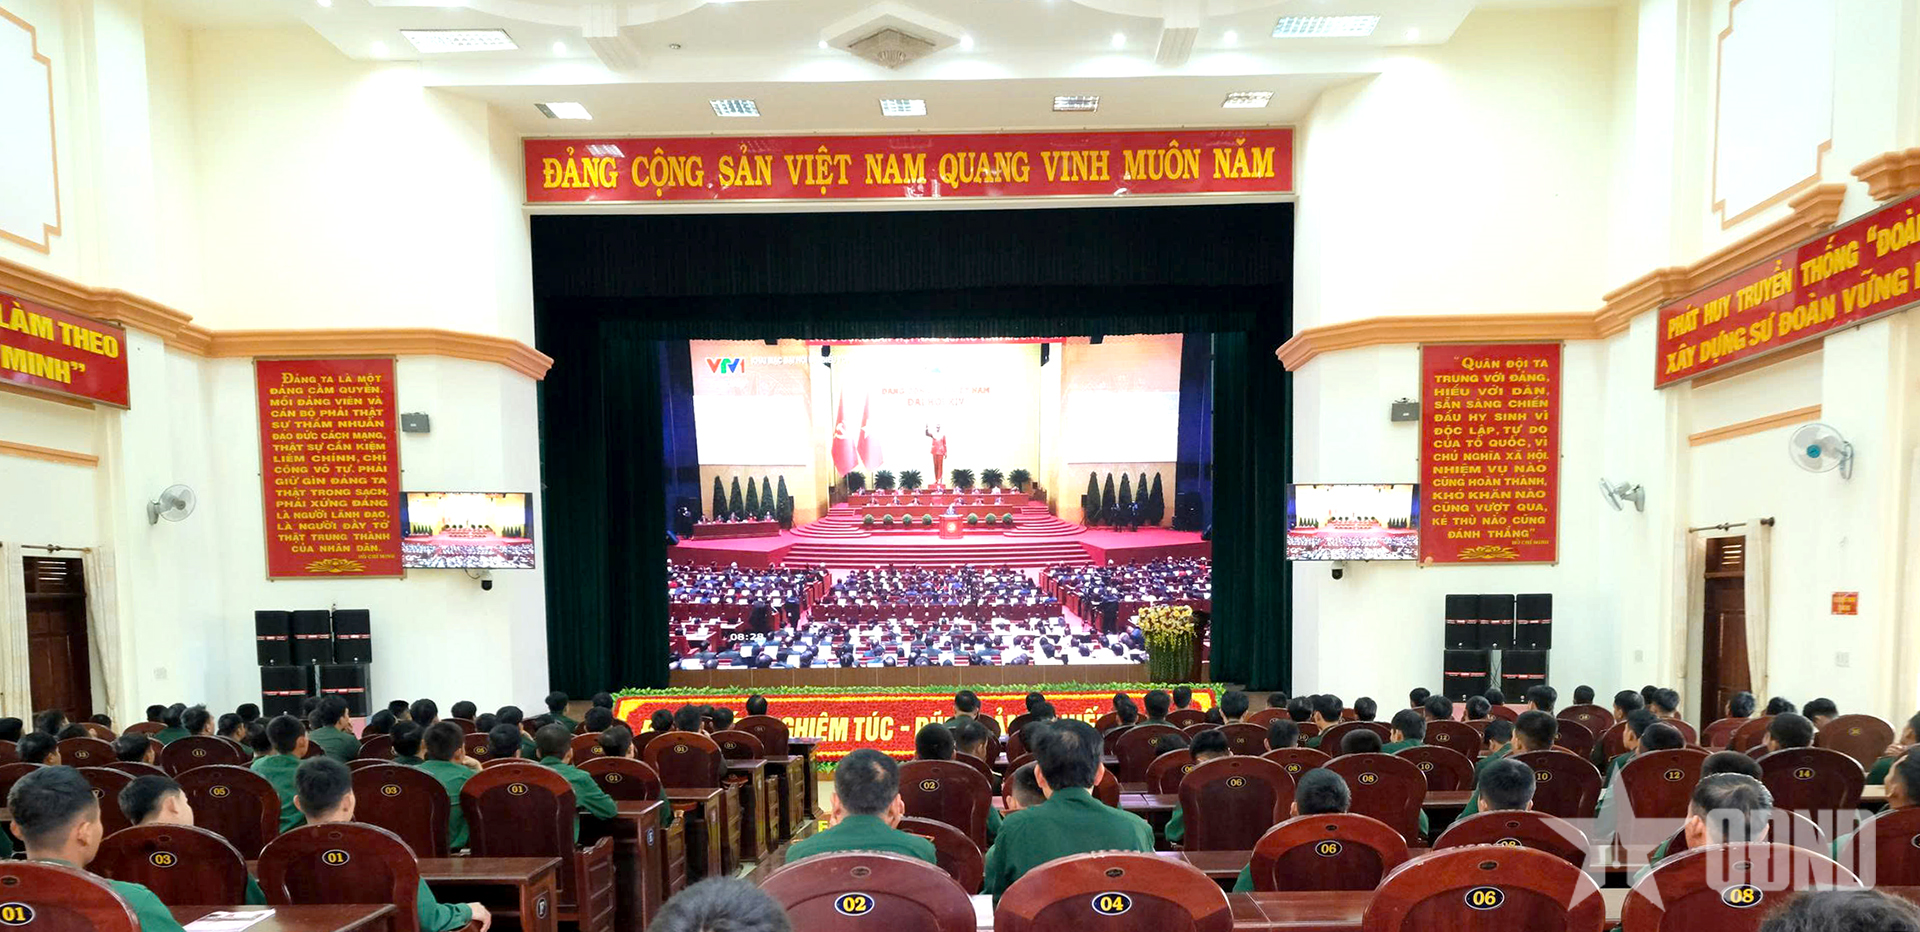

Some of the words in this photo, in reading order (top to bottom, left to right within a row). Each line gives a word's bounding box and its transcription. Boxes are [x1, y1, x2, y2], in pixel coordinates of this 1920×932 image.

[543, 147, 618, 188] ĐẢNG
[632, 147, 704, 197] CỘNG
[718, 143, 772, 186] SẢN
[784, 146, 851, 195] VIỆT
[866, 153, 927, 185] NAM
[939, 151, 1029, 188] QUANG
[1041, 151, 1109, 182] VINH
[1123, 139, 1200, 180] MUÔN
[1213, 138, 1275, 179] NĂM
[1667, 304, 1700, 340] PHÁT
[1703, 295, 1731, 325] HUY
[1736, 259, 1793, 313] TRUYỀN
[1801, 235, 1859, 287] THỐNG
[1665, 343, 1696, 375] XÂY
[1700, 331, 1746, 363] DỰNG
[1748, 312, 1776, 346] SƯ
[1778, 292, 1836, 337] ĐOÀN
[1841, 268, 1909, 313] VỮNG
[57, 321, 119, 358] THEO
[1506, 357, 1528, 370] ĐỘI
[1533, 360, 1548, 368] TA
[281, 372, 316, 384] ĐẢNG
[339, 373, 352, 382] LÀ
[358, 373, 381, 384] MỘT
[1483, 371, 1504, 382] VỚI
[270, 384, 303, 395] ĐẢNG
[308, 383, 334, 394] CẦM
[1434, 384, 1470, 396] HIẾU
[1478, 385, 1503, 395] VỚI
[270, 396, 292, 406] MỖI
[297, 395, 331, 406] ĐẢNG
[335, 396, 362, 405] VIÊN
[368, 396, 382, 405] VÀ
[1434, 397, 1460, 409] SẴN
[1467, 398, 1501, 408] SÀNG
[1509, 396, 1548, 408] CHIẾN
[271, 408, 296, 417] CÁN
[300, 408, 316, 419] BỘ
[320, 406, 348, 416] PHẢI
[352, 407, 383, 418] THẬT
[1434, 410, 1461, 421] ĐẤU
[1494, 413, 1526, 421] SINH
[1535, 410, 1548, 420] VÌ
[272, 420, 291, 431] SỰ
[295, 418, 332, 428] THẤM
[1503, 424, 1523, 436] TỰ
[1529, 426, 1547, 434] DO
[296, 430, 318, 440] ĐỨC
[321, 430, 349, 439] CÁCH
[273, 442, 303, 453] THẬT
[308, 442, 324, 453] SỰ
[327, 440, 352, 451] CẦN
[356, 441, 386, 452] KIỆM
[1434, 438, 1460, 447] CỦA
[1535, 436, 1547, 446] VÌ
[273, 453, 305, 462] LIÊM
[363, 451, 386, 461] CHÍ
[1434, 449, 1458, 461] CHỦ
[1463, 451, 1501, 460] NGHĨA
[1506, 450, 1522, 460] XÃ
[274, 464, 308, 473] CÔNG
[314, 464, 329, 473] VÔ
[358, 463, 387, 472] PHẢI
[1433, 463, 1481, 476] NHIỆM
[1487, 465, 1508, 475] VỤ
[1514, 462, 1546, 473] NÀO
[275, 476, 299, 485] GIỮ
[302, 475, 326, 484] GÌN
[330, 474, 367, 484] ĐẢNG
[1433, 476, 1465, 486] CŨNG
[1468, 476, 1501, 486] HOÀN
[276, 487, 306, 498] THẬT
[1432, 489, 1464, 499] KHÓ
[1468, 488, 1511, 499] KHĂN
[1515, 488, 1546, 498] NÀO
[276, 496, 306, 507] PHẢI
[311, 498, 348, 507] XỨNG
[1432, 502, 1469, 512] CŨNG
[1475, 502, 1510, 514] VƯỢT
[276, 510, 290, 519] LÀ
[294, 509, 327, 518] NGƯỜI
[331, 509, 360, 518] LÃNH
[1453, 514, 1476, 525] THÙ
[1482, 515, 1506, 525] NÀO
[1513, 514, 1545, 524] CŨNG
[277, 521, 292, 530] LÀ
[299, 521, 336, 530] NGƯỜI
[343, 519, 366, 529] ĐẦY
[278, 532, 305, 543] THẬT
[353, 531, 390, 540] THÀNH
[1448, 528, 1480, 538] ĐÁNH
[291, 542, 314, 552] CỦA
[320, 543, 351, 552] NHÂN
[730, 632, 764, 641] 08:28
[854, 711, 894, 742] TÚC
[1420, 761, 1432, 771] 10
[607, 773, 619, 782] 01
[1361, 772, 1375, 783] 08
[1536, 771, 1549, 781] 10
[1668, 769, 1681, 780] 12
[1797, 768, 1811, 779] 14
[384, 785, 398, 795] 03
[511, 783, 525, 793] 01
[923, 779, 936, 790] 02
[212, 786, 227, 797] 05
[1320, 843, 1338, 855] 06
[154, 853, 172, 866] 03
[327, 852, 344, 864] 01
[1473, 890, 1497, 906] 06
[1729, 889, 1755, 904] 08
[842, 896, 867, 912] 02
[1100, 896, 1124, 912] 04
[1, 907, 26, 922] 01
